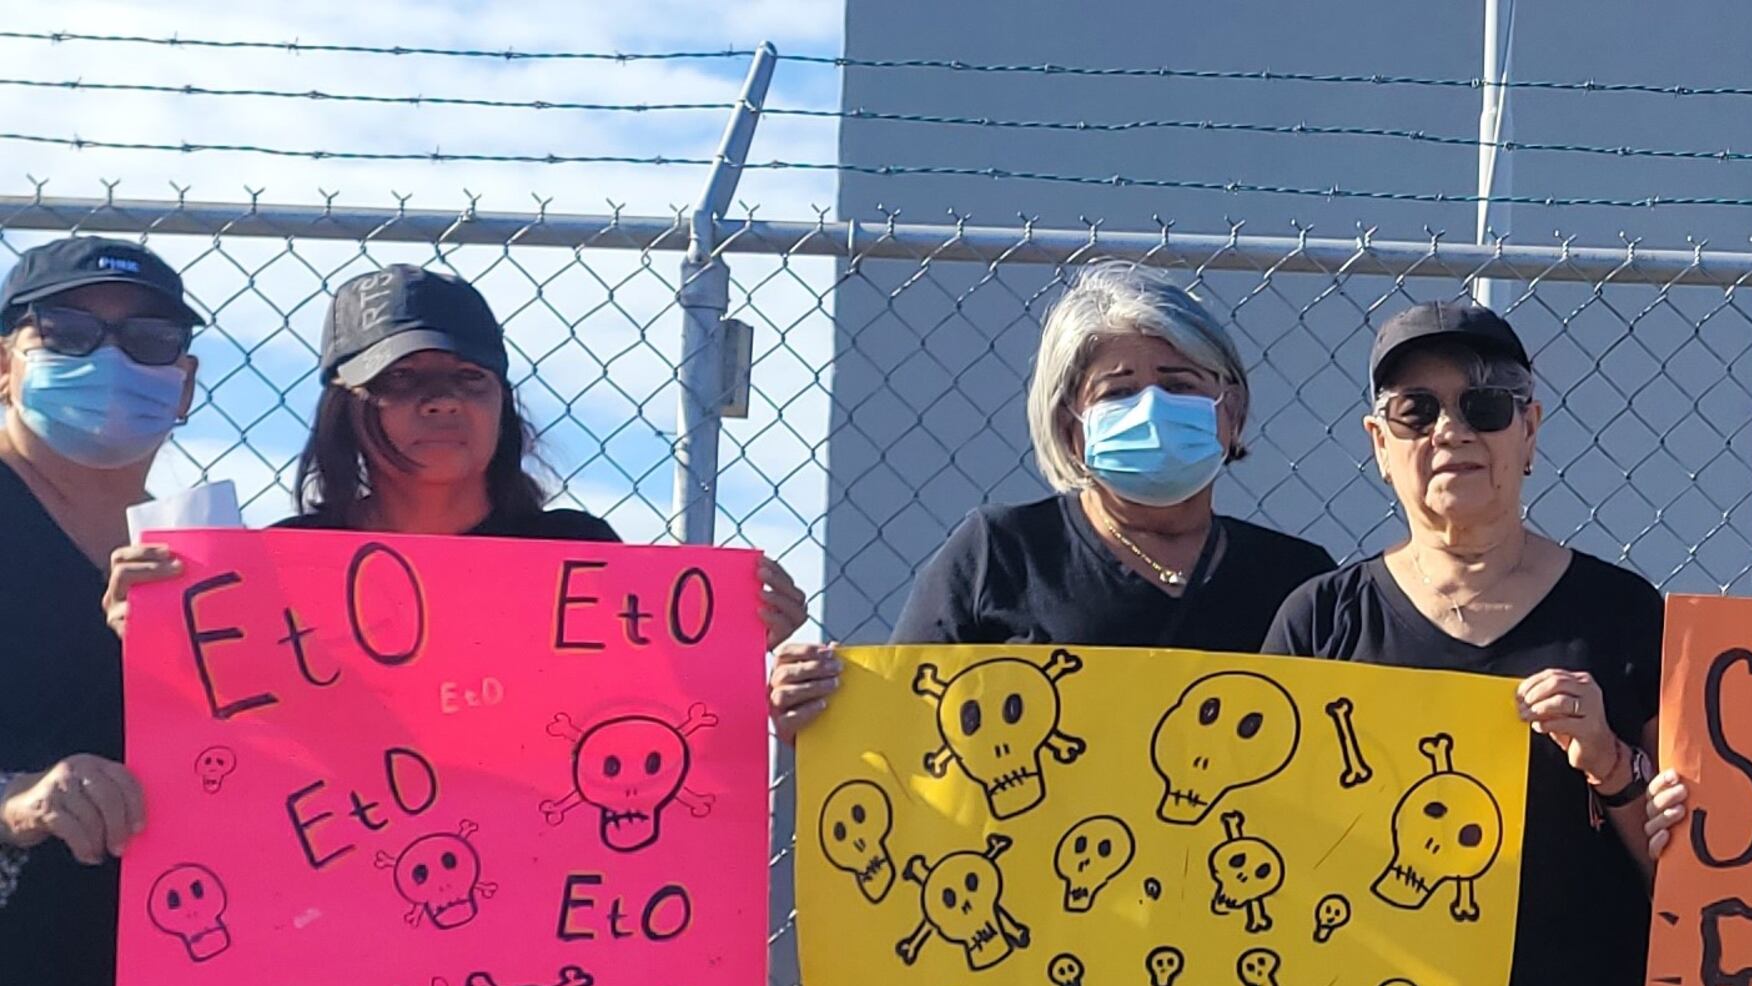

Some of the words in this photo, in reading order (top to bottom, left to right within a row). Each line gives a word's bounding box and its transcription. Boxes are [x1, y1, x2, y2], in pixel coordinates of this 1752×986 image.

[182, 541, 425, 720] EtO
[553, 559, 714, 651] EtO
[286, 748, 437, 869] EtO
[556, 874, 693, 942] EtO
